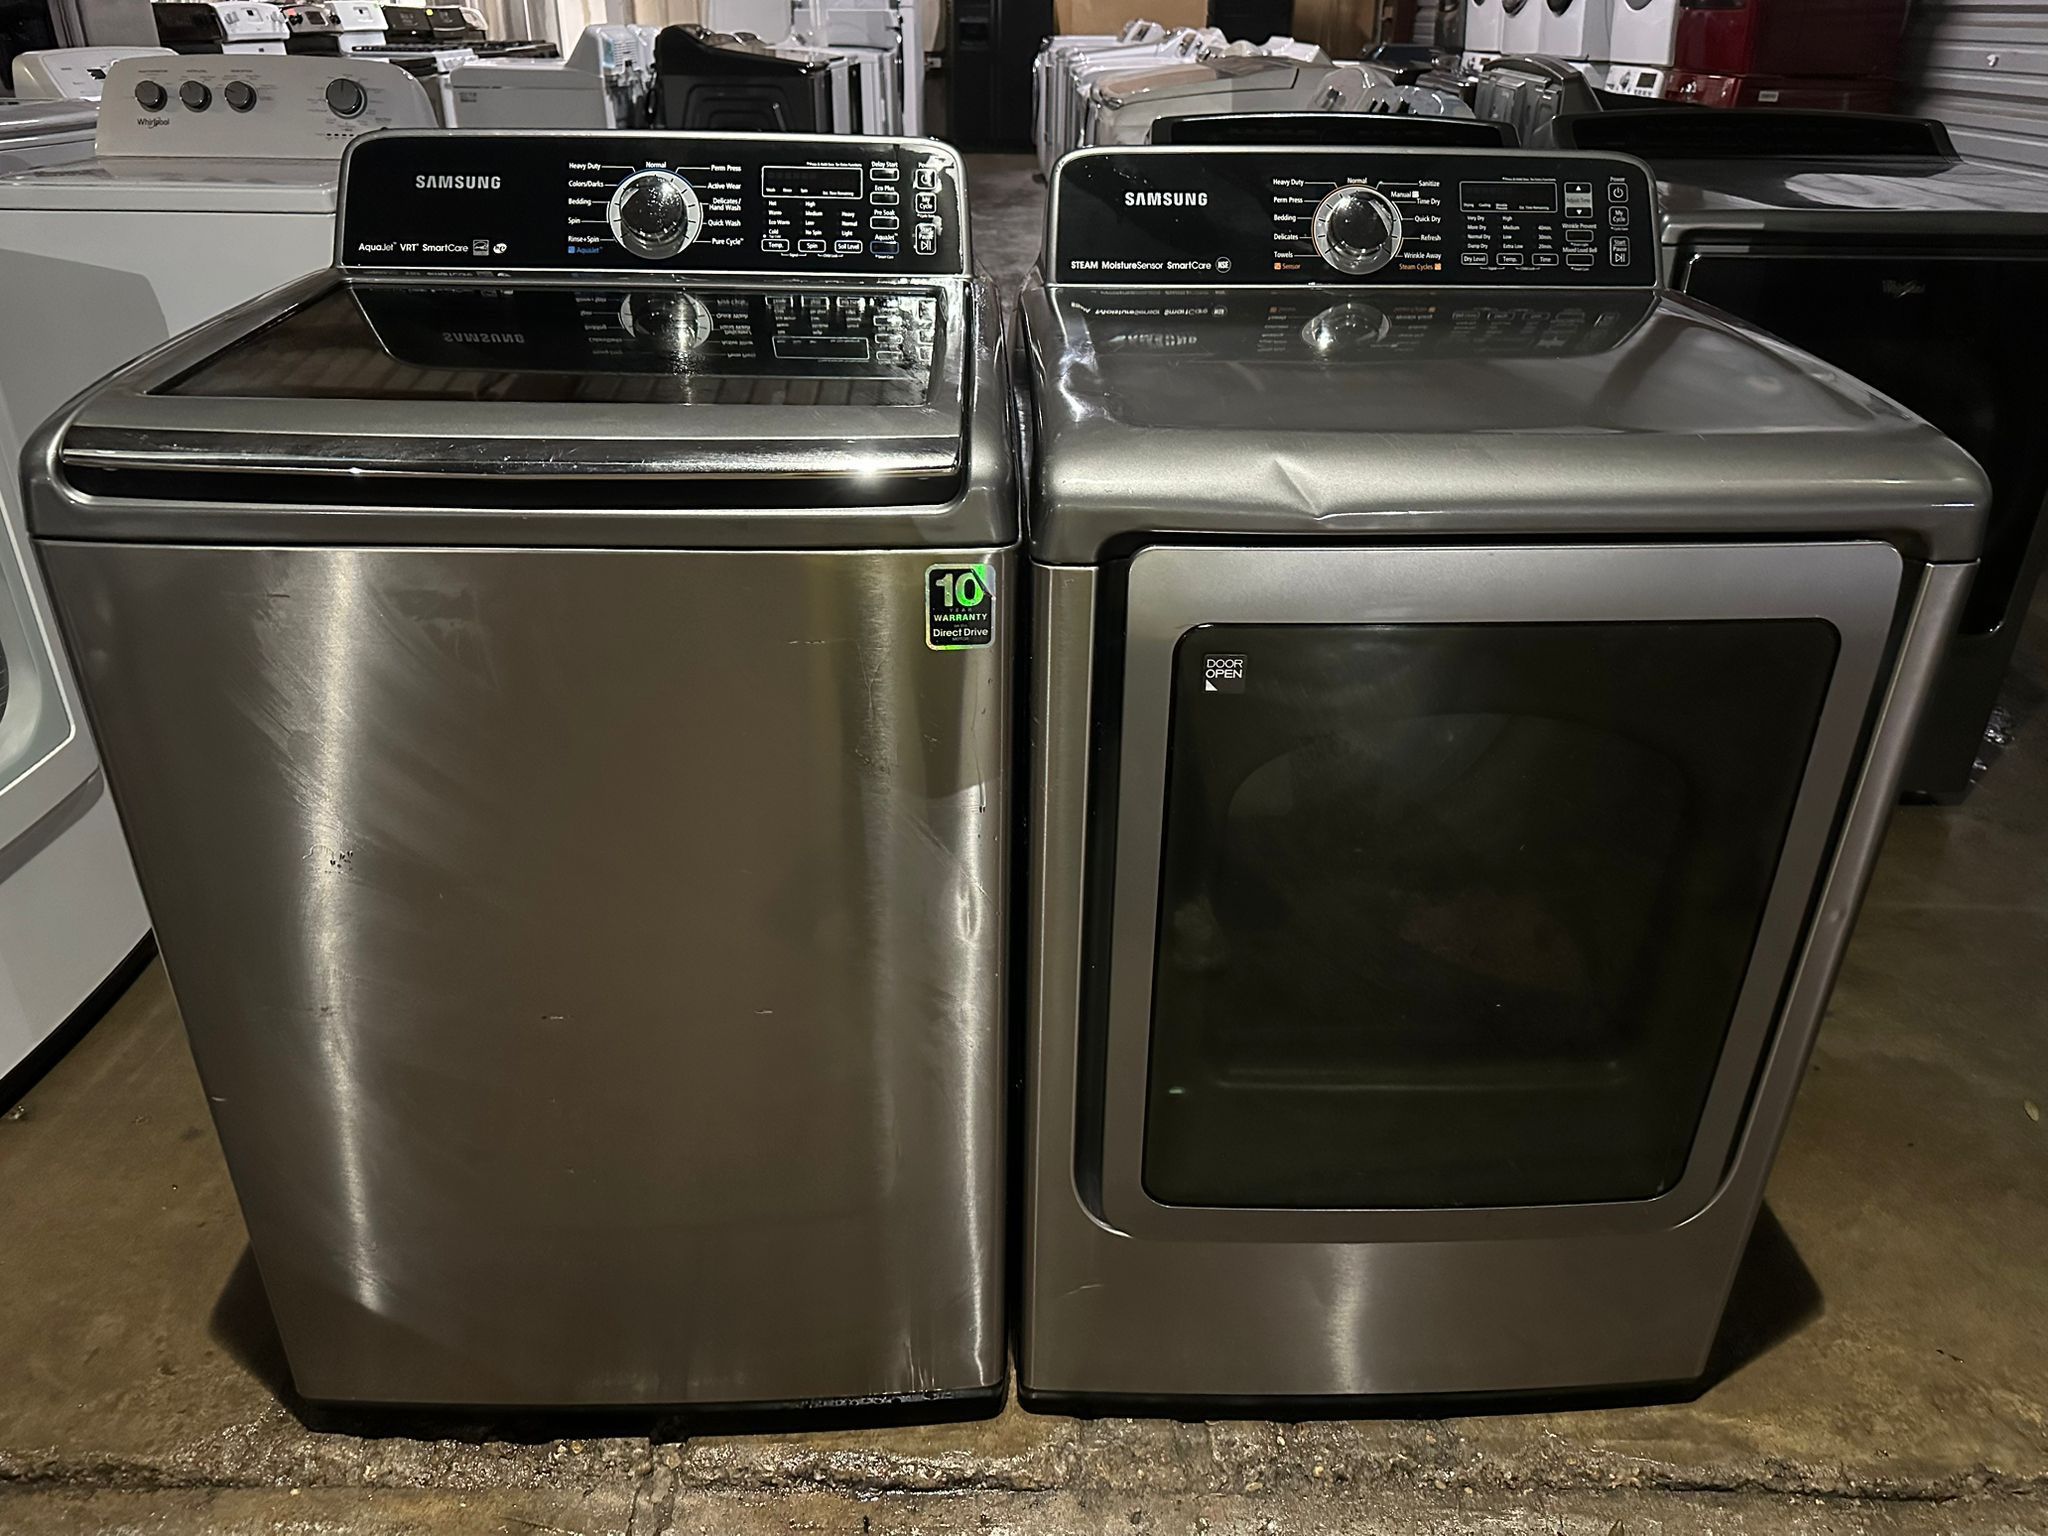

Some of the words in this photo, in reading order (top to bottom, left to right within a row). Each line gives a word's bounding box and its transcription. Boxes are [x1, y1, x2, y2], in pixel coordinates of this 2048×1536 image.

[569, 162, 586, 171] Heavy
[587, 163, 601, 171] Duty
[416, 175, 501, 189] SAMSUNG
[568, 198, 592, 206] Bedding
[1124, 192, 1208, 206] SAMSUNG
[568, 217, 581, 225] Spin
[568, 236, 599, 244] Rinse+Spin
[422, 244, 468, 252] SmartCare
[768, 242, 784, 250] Temp.
[1071, 261, 1098, 269] STEAM
[1102, 261, 1163, 270] MoistureSensor
[1167, 261, 1212, 270] SmartCare
[936, 572, 984, 607] 10
[933, 613, 988, 622] WARRANTY
[933, 628, 962, 637] Direct
[964, 628, 988, 636] Drive
[1207, 659, 1243, 668] DOOR
[1206, 669, 1242, 678] OPEN
